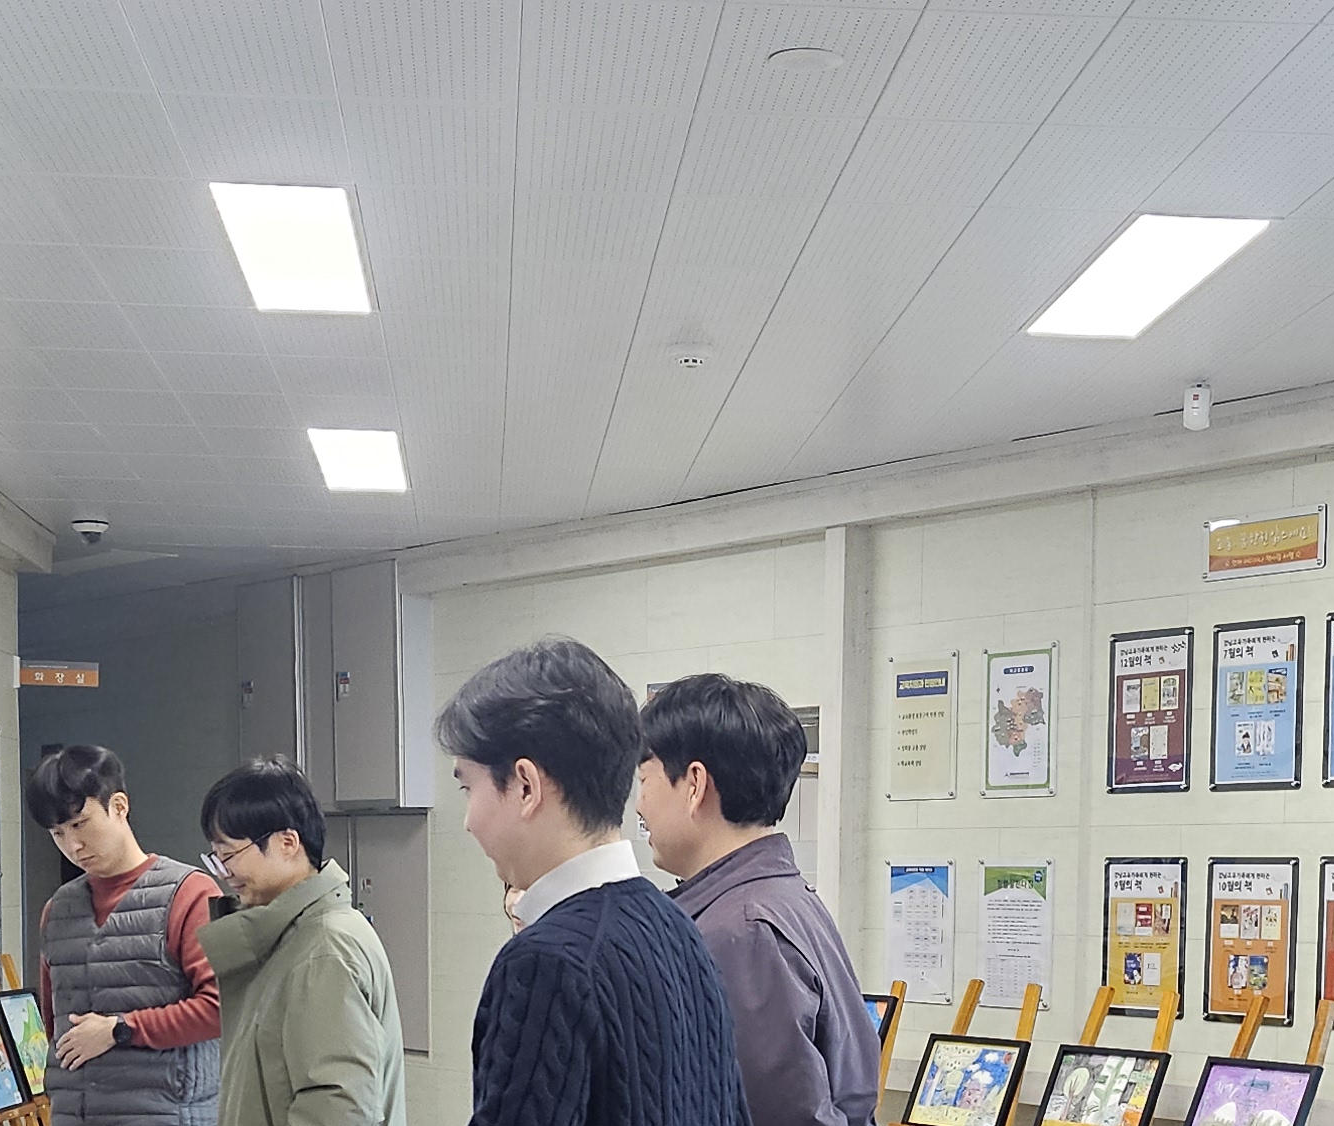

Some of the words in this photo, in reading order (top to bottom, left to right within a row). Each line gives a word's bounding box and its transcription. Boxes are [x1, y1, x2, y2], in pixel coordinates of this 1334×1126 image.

[1223, 646, 1243, 659] 7월의
[1246, 646, 1254, 657] 책
[1120, 656, 1142, 667] 12월의
[1144, 655, 1151, 665] 책
[34, 672, 85, 684] 화장실
[1114, 880, 1132, 890] 9월의
[1135, 880, 1142, 890] 책
[1219, 881, 1241, 892] 10월의
[1244, 881, 1252, 892] 책
